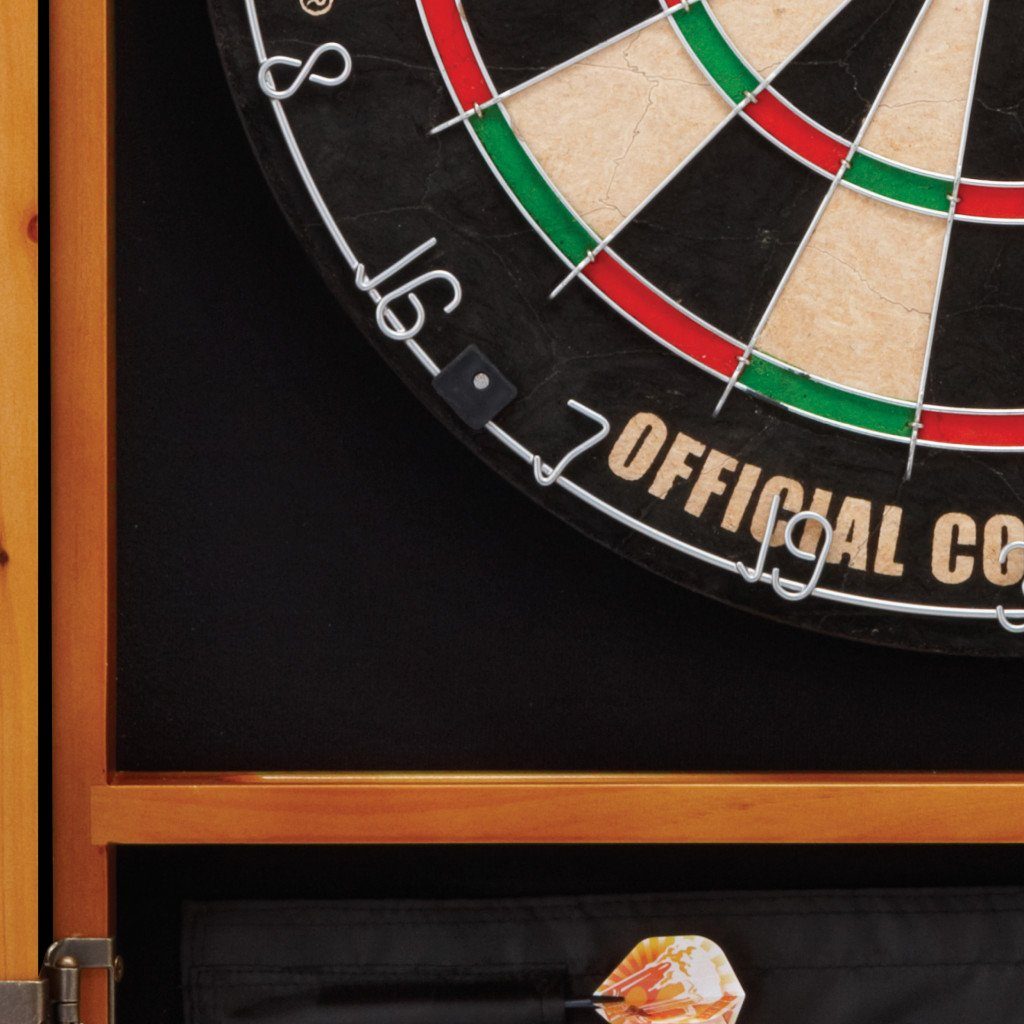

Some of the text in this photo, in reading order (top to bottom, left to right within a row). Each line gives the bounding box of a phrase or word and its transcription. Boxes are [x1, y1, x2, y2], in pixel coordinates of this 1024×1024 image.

[258, 42, 352, 99] 8
[356, 237, 462, 341] 16
[532, 399, 610, 486] 7
[608, 411, 904, 577] OFFICIAL
[736, 494, 833, 600] 19
